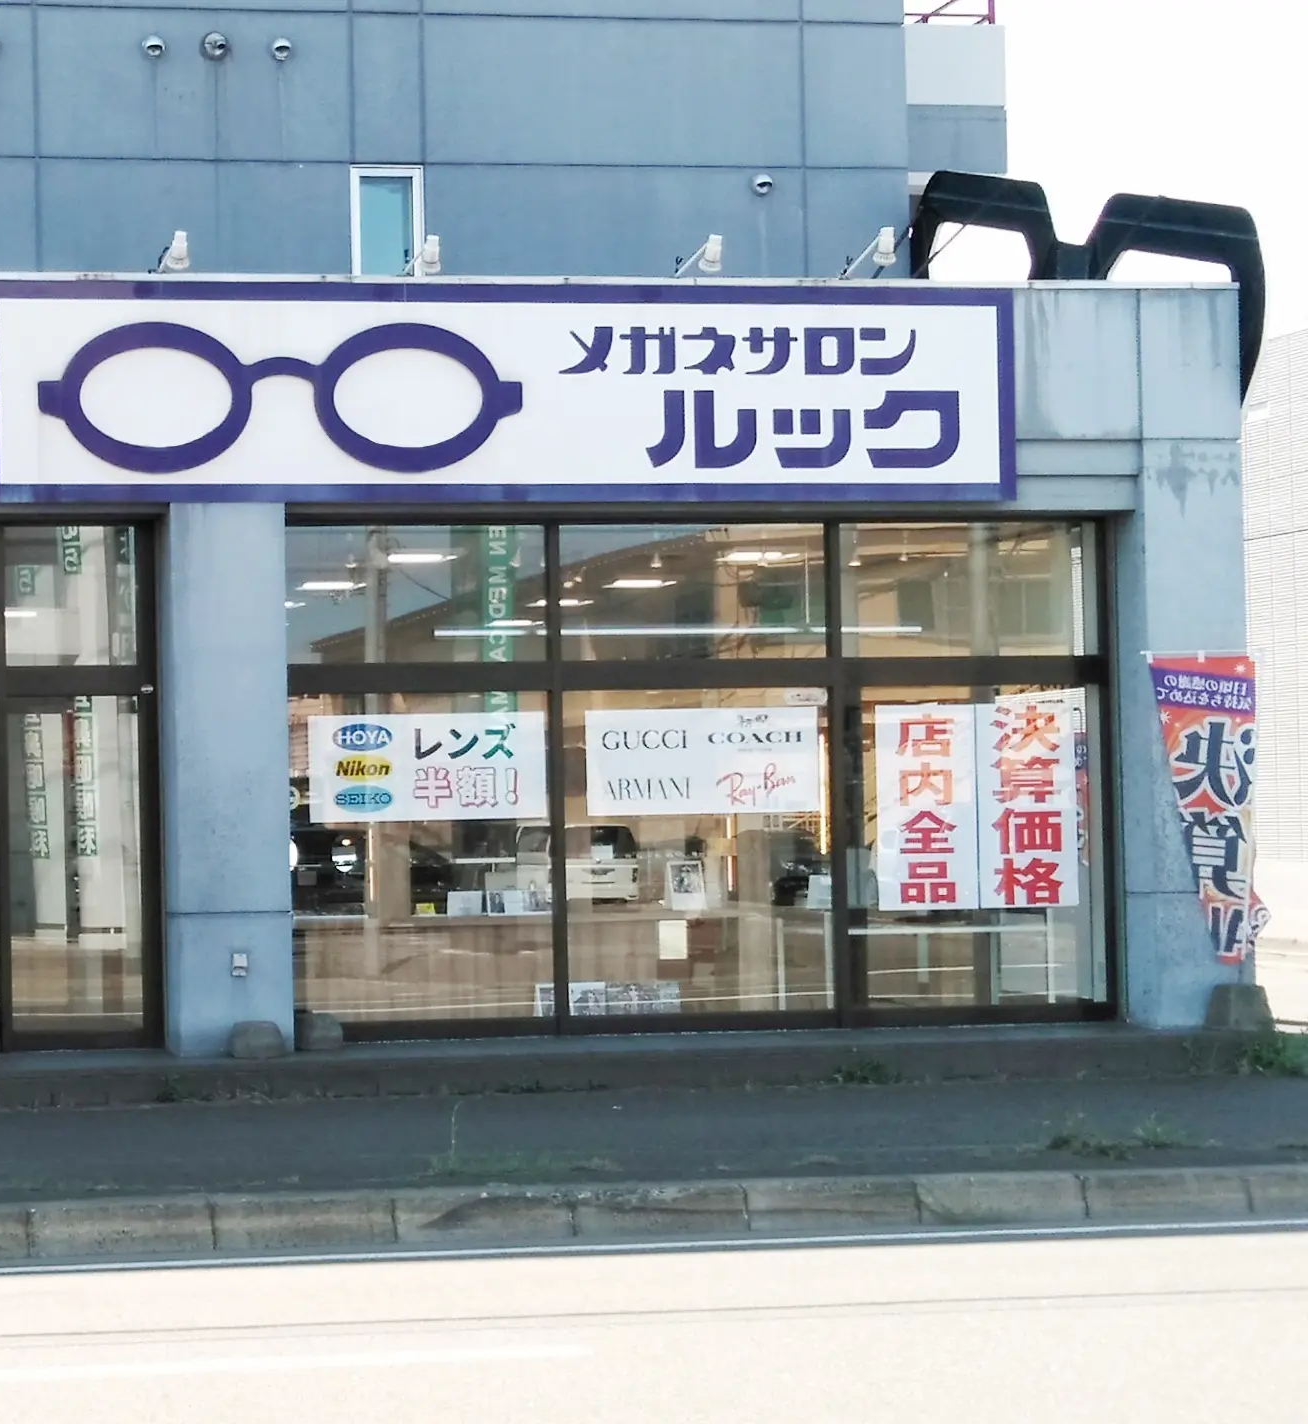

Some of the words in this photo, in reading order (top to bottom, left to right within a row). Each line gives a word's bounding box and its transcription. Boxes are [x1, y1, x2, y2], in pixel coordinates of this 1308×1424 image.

[558, 326, 916, 375] メガネサロン
[645, 390, 960, 469] ルック
[337, 731, 390, 745] HOYA
[414, 722, 517, 760] レンズ
[601, 729, 688, 750] GUCCI
[708, 730, 803, 744] COACH
[335, 760, 390, 777] Nikon
[716, 762, 797, 806] Ray-Ban
[335, 792, 392, 807] SEIKO
[604, 776, 691, 800] ARMANI
[896, 713, 958, 904] 店内全品
[990, 705, 1064, 905] 決算価格
